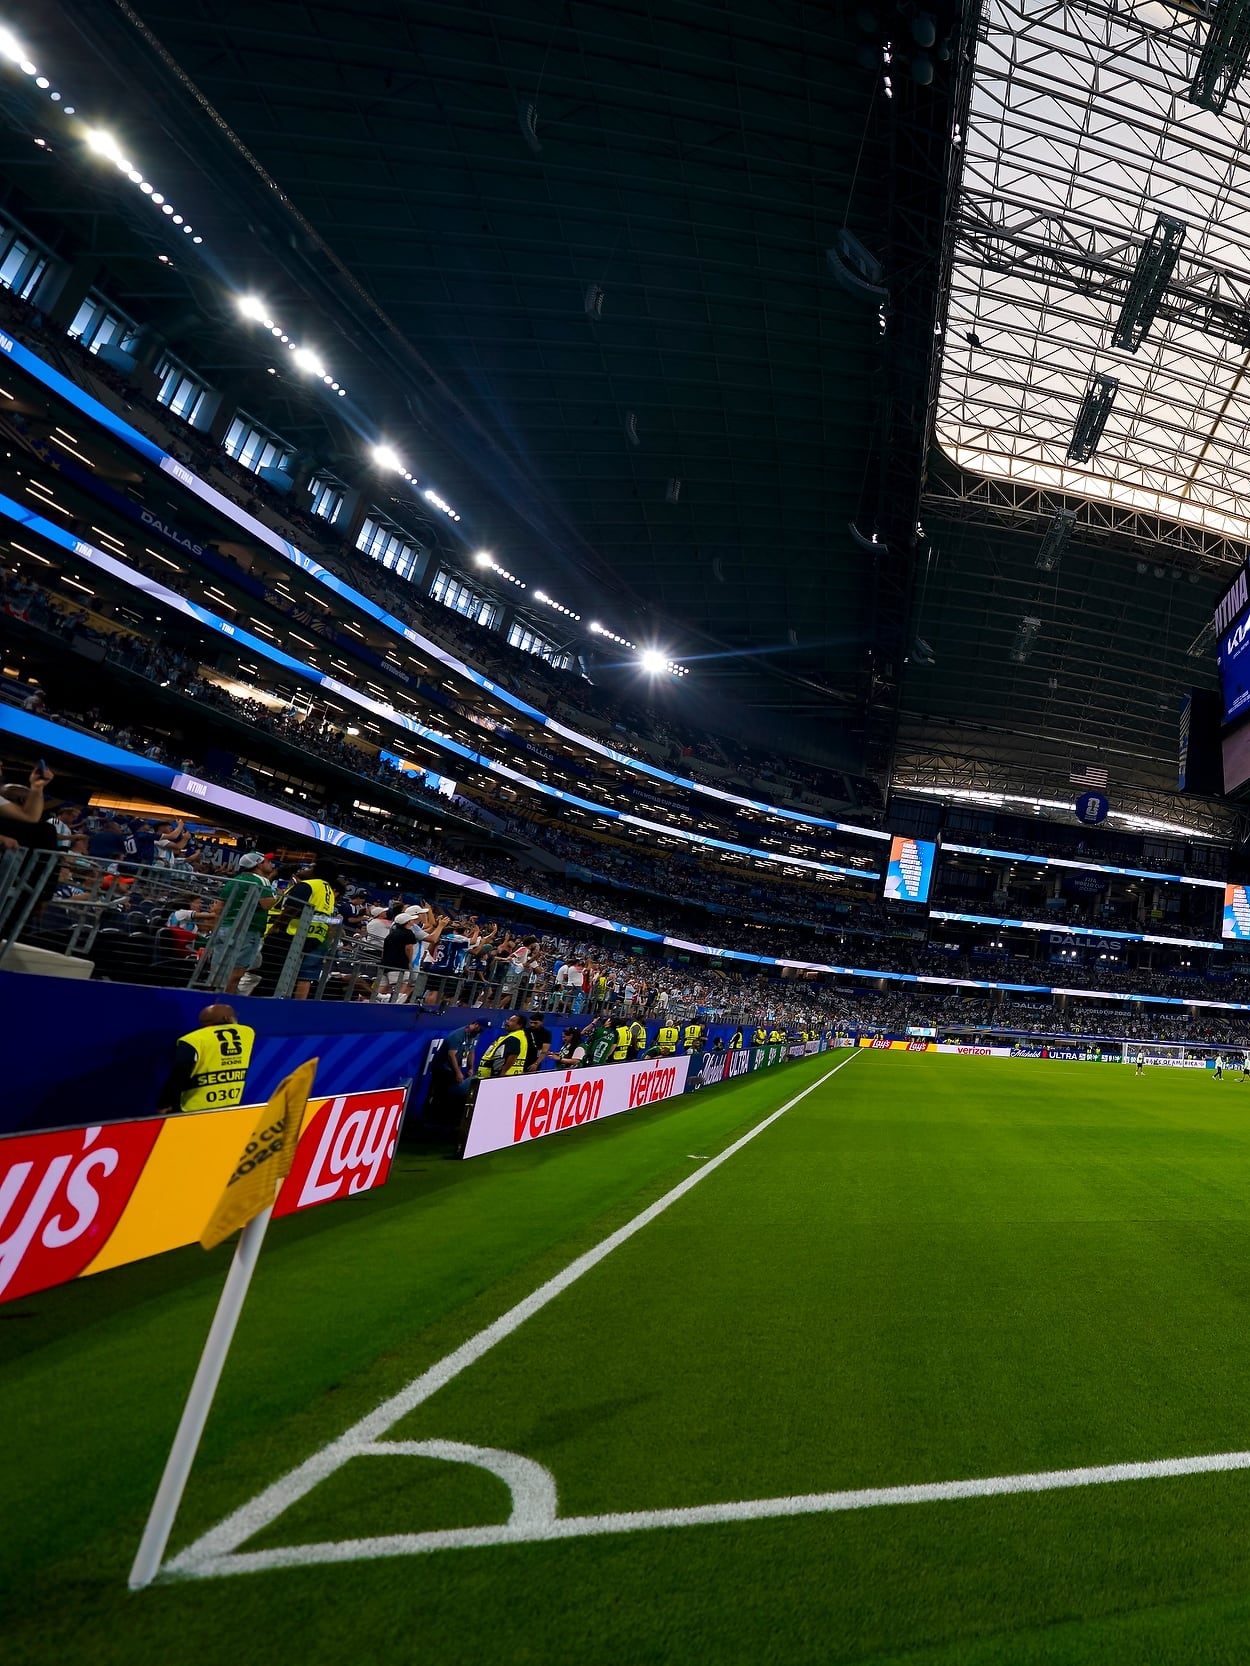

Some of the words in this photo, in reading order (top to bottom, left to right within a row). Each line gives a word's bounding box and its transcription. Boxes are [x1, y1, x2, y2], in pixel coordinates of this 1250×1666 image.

[141, 511, 202, 556] DALLAS
[1215, 569, 1248, 638] NTINA
[526, 743, 554, 761] DALLAS
[187, 780, 208, 797] NTINA
[1049, 934, 1121, 950] DALLAS
[1012, 1001, 1052, 1011] DALLAS
[1153, 1013, 1189, 1022] ALLAS
[957, 1046, 992, 1056] verizon
[1010, 1049, 1042, 1058] Michelob
[1049, 1052, 1077, 1060] ULTRA
[729, 1050, 750, 1077] ULTRA
[198, 1070, 246, 1086] SECURI
[629, 1060, 676, 1108] verizon
[514, 1071, 605, 1142] verizon
